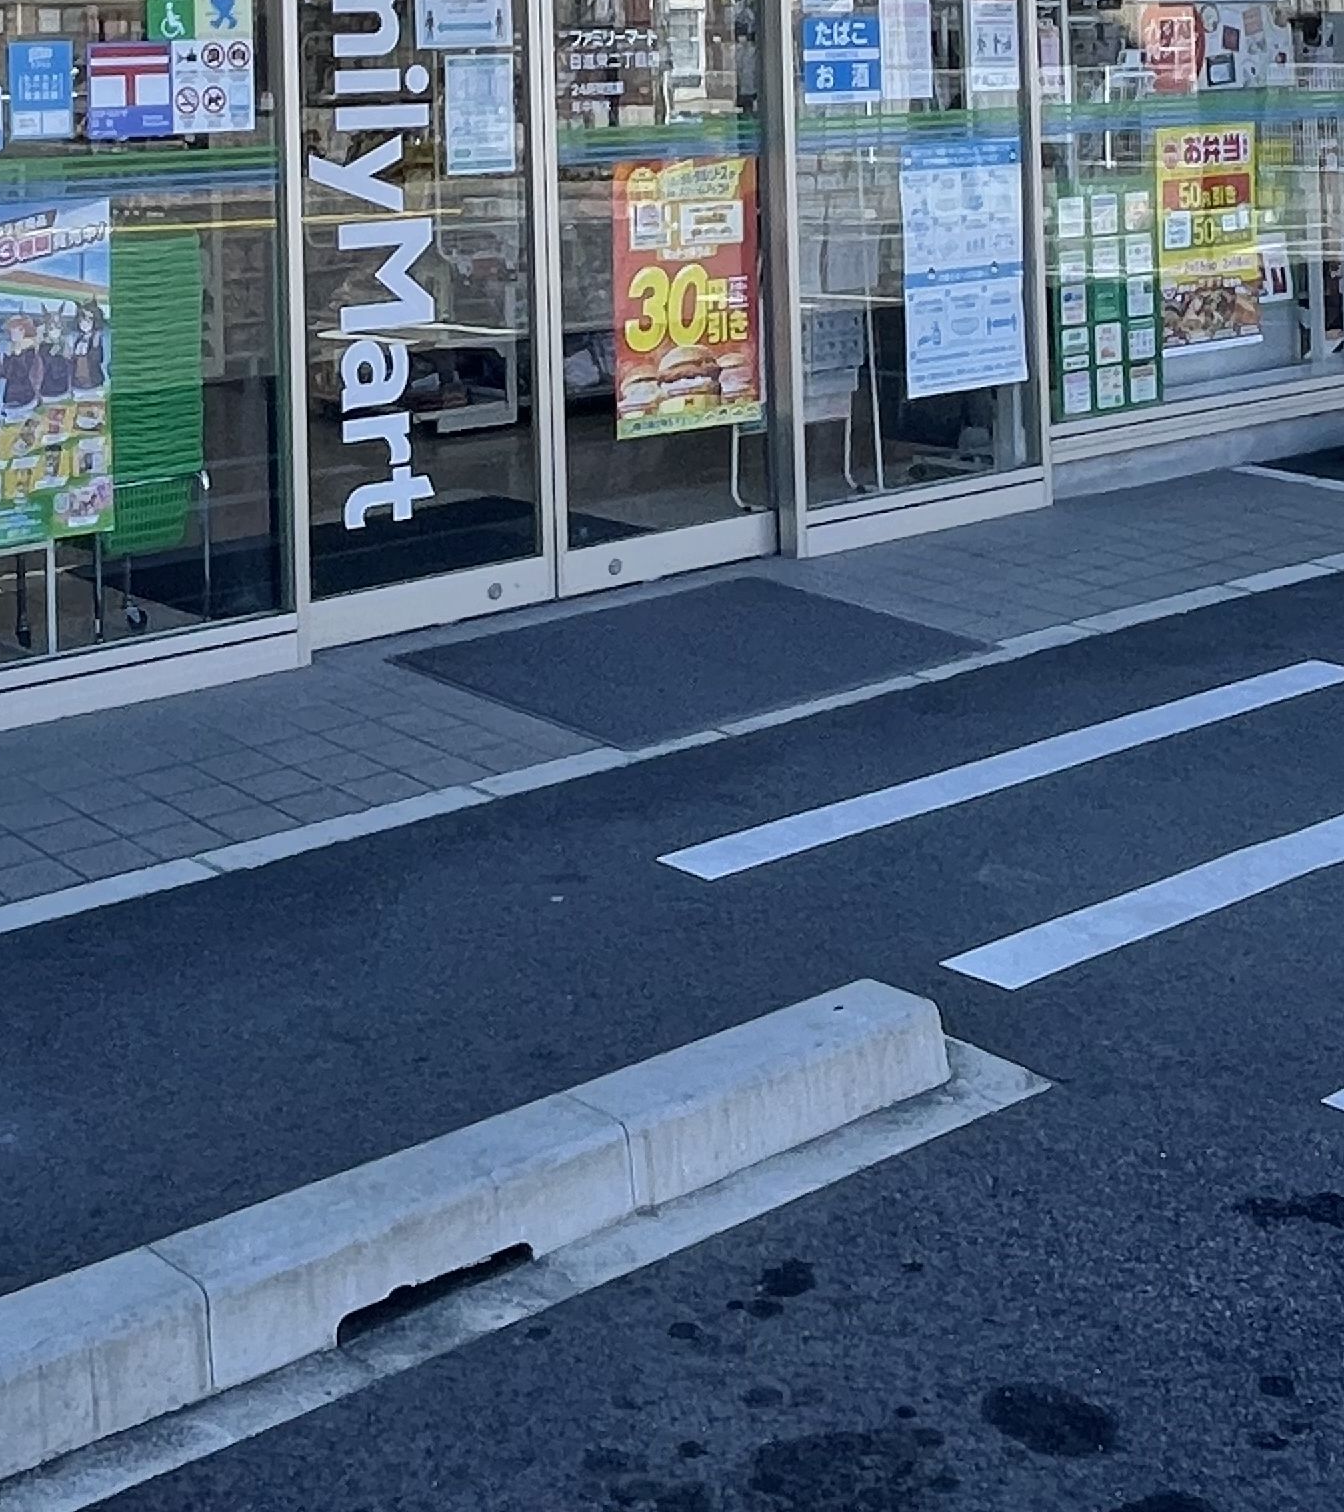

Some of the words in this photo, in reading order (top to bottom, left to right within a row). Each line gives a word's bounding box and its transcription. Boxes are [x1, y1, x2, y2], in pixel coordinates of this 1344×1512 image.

[568, 29, 657, 47] ファミリーマート
[815, 20, 869, 46] たばこ
